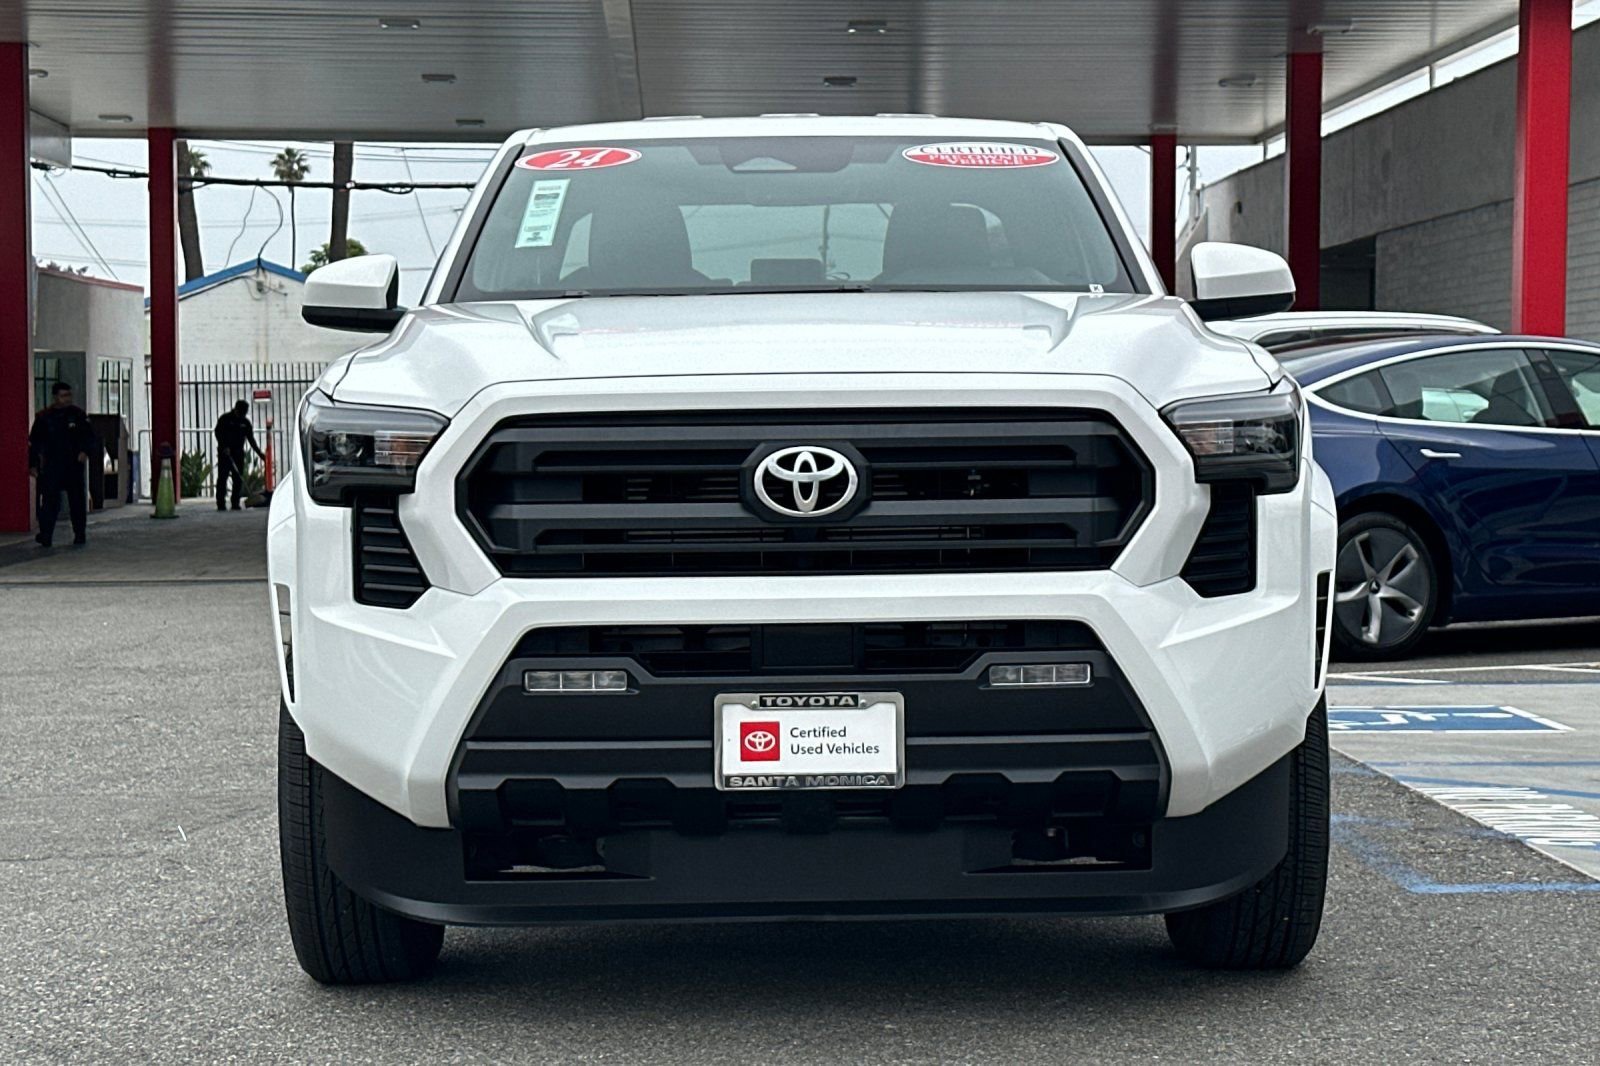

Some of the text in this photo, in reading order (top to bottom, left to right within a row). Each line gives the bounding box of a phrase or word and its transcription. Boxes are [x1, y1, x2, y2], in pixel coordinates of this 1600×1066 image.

[919, 145, 1039, 155] CERTIFIED
[544, 149, 612, 169] 24
[762, 696, 855, 707] TOYOTA
[790, 726, 847, 738] Certified
[790, 742, 880, 755] Used Vehicles
[729, 774, 890, 787] SANTA MONICA
